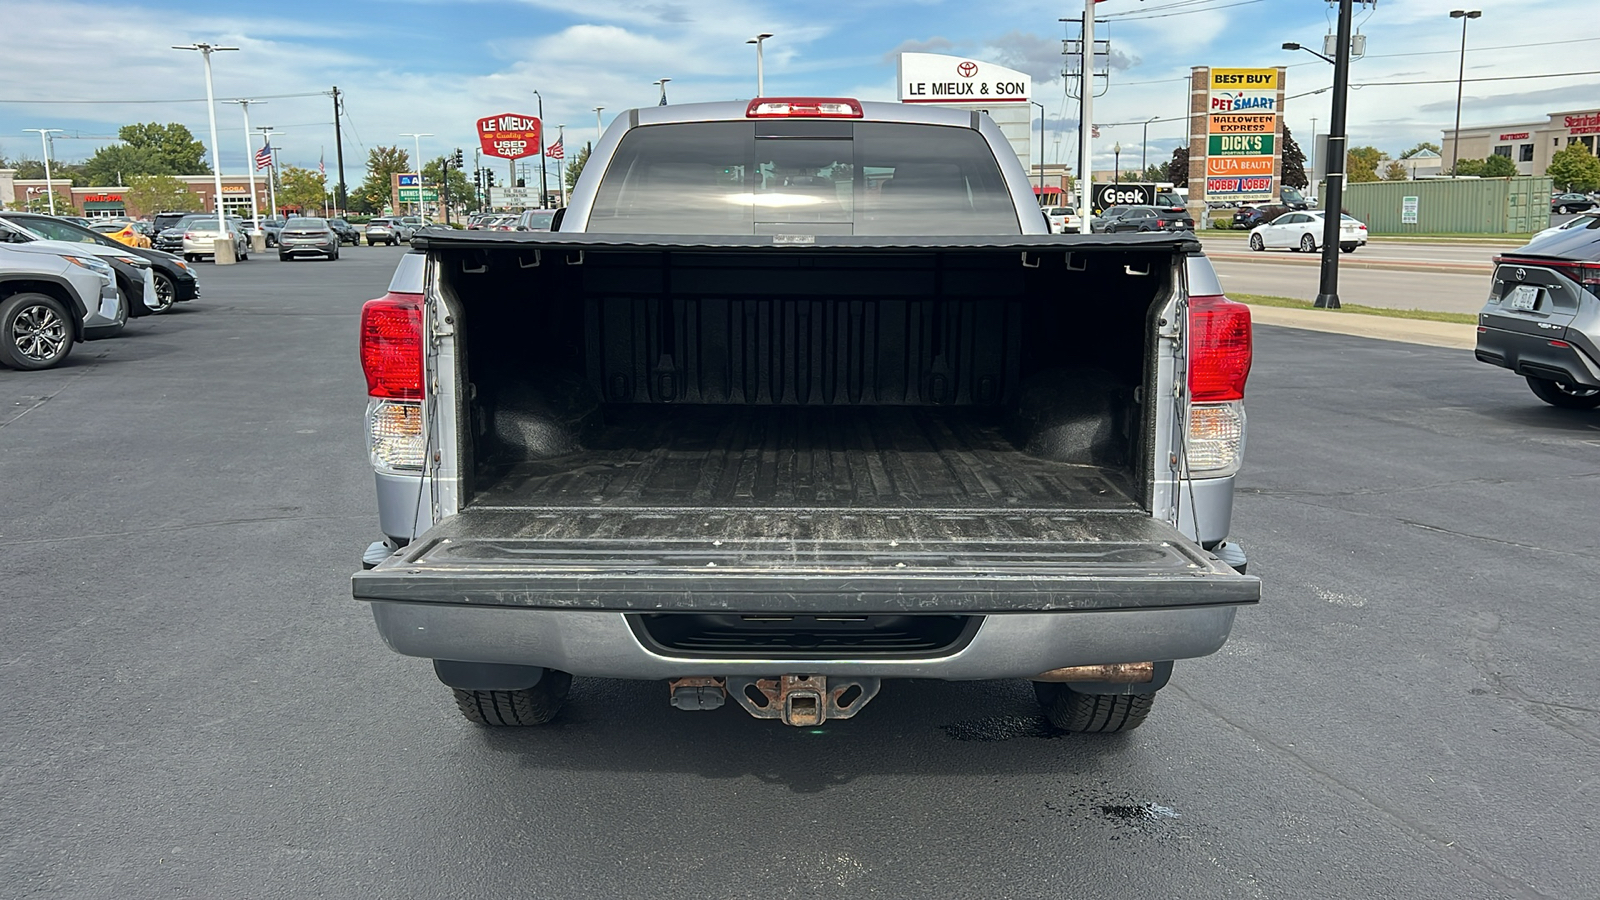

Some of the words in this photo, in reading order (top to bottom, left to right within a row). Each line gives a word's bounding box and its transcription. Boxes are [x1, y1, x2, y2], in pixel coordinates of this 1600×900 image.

[1215, 75, 1244, 83] BEST
[1247, 75, 1272, 83] BUY
[909, 83, 926, 95] LE
[932, 82, 974, 95] MIEUX
[980, 82, 989, 95] &
[996, 82, 1025, 94] SON
[482, 119, 496, 131] LE
[498, 116, 535, 131] MIEUX
[493, 140, 527, 148] USED
[1221, 136, 1262, 150] DICK'S
[497, 147, 524, 156] CARS
[1212, 159, 1238, 170] ULTA
[1241, 161, 1272, 169] BEAUTY
[1208, 178, 1239, 192] HOBBY
[1242, 178, 1271, 191] LOBBY
[1104, 188, 1144, 203] Geek
